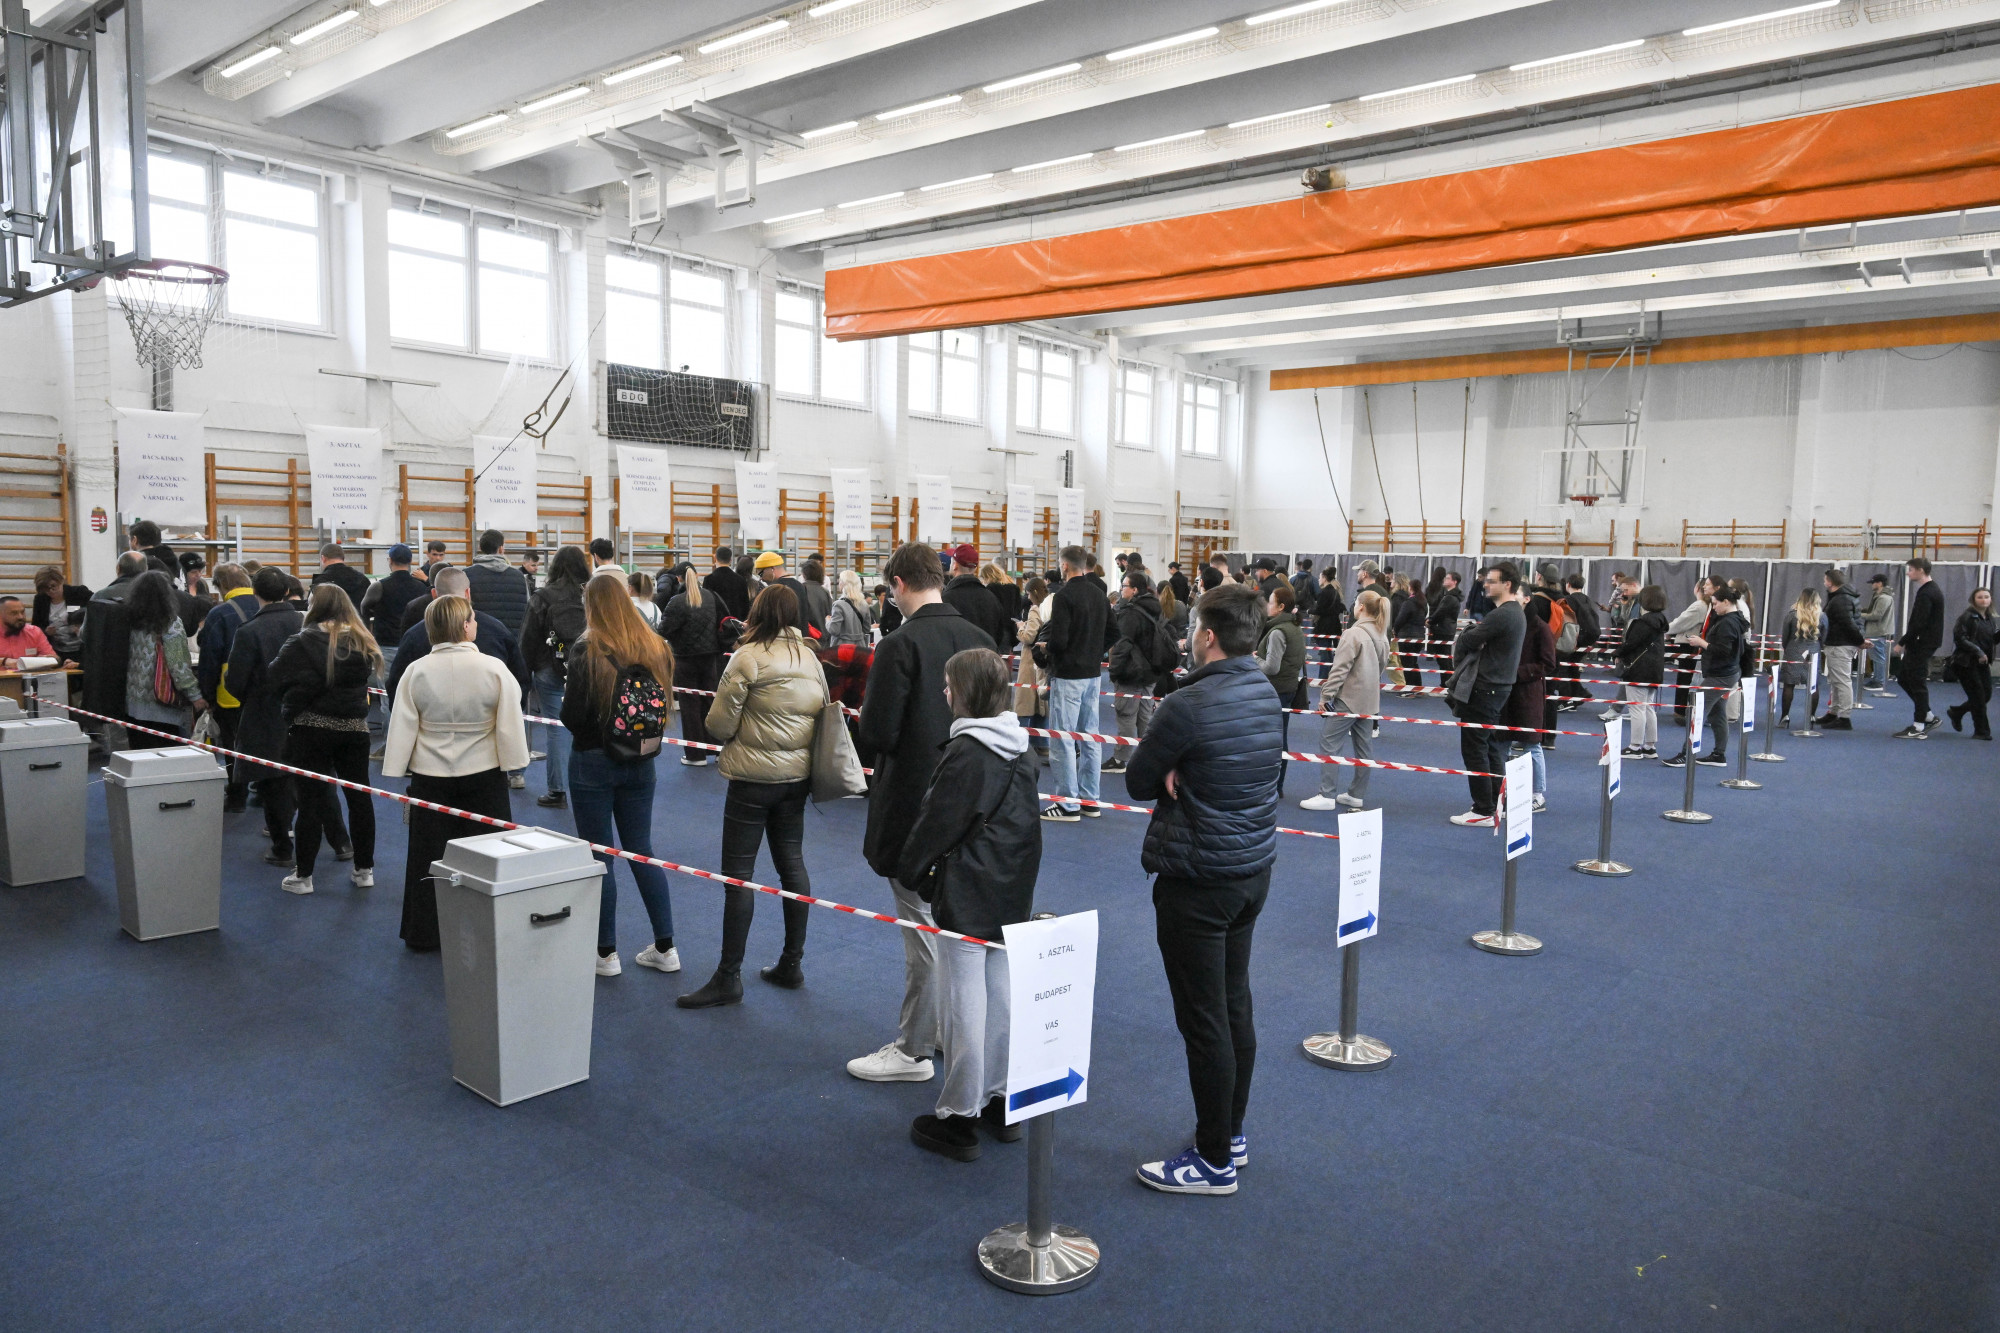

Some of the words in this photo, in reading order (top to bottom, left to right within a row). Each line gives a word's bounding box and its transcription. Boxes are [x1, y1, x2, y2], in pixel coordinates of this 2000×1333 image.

[621, 391, 644, 402] BDG
[1047, 943, 1075, 958] ASZTAL
[1034, 983, 1072, 1002] BUDAPEST
[1044, 1019, 1059, 1031] VAS
